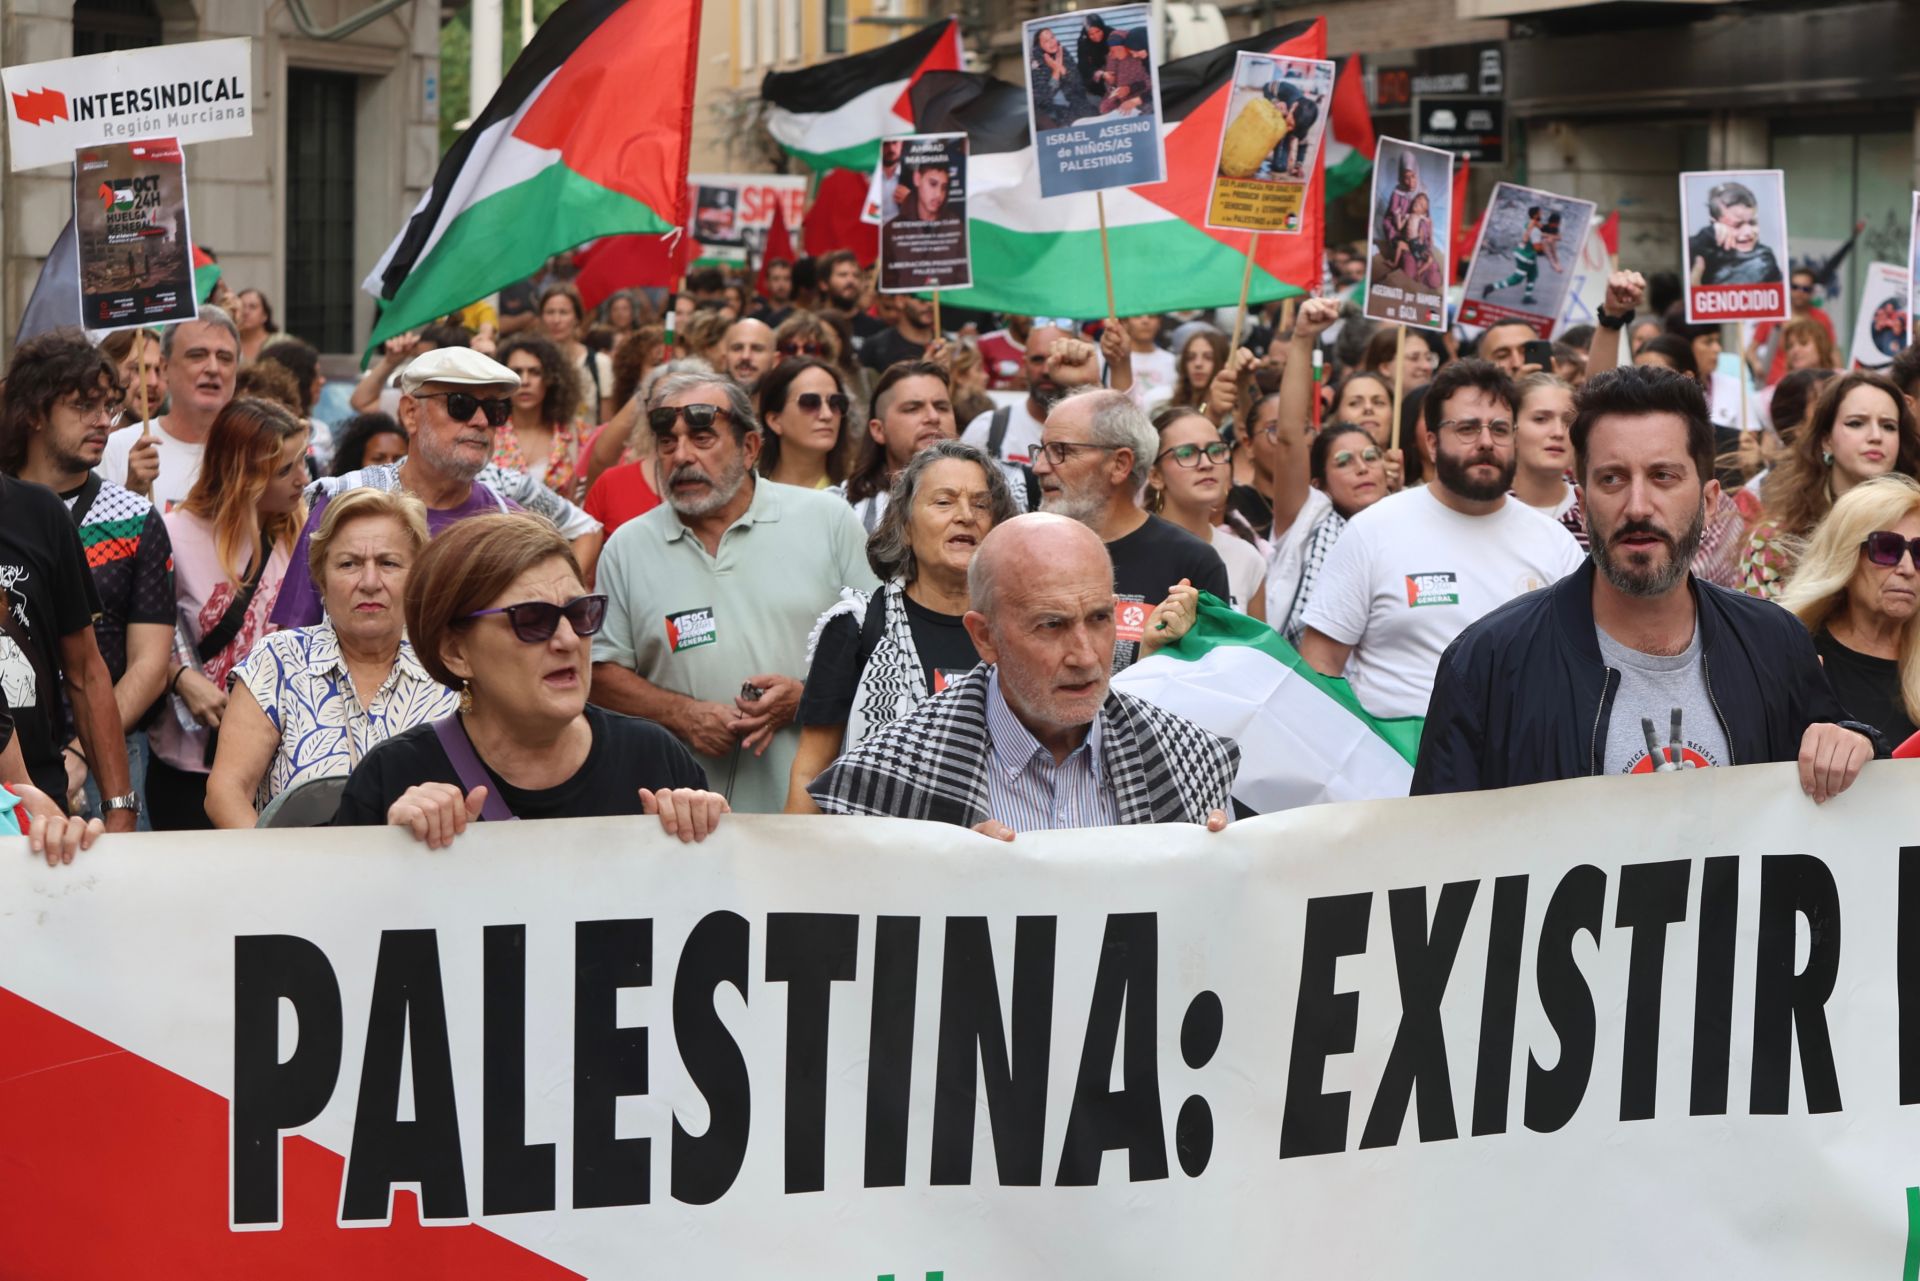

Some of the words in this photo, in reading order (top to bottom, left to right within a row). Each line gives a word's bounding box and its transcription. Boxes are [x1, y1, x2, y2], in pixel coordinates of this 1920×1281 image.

[73, 76, 245, 122] INTERSINDICAL
[103, 116, 161, 137] Región
[168, 105, 246, 128] Murciana
[1046, 131, 1090, 146] ISRAEL
[1099, 121, 1151, 138] ASESINO
[1057, 147, 1073, 159] de
[1074, 137, 1133, 157] NIÑOS/AS
[1060, 151, 1134, 173] PALESTINOS
[98, 178, 135, 213] 15
[133, 174, 161, 194] OCT
[134, 191, 161, 210] 24H
[106, 210, 147, 223] HUELGA
[1694, 289, 1780, 313] GENOCIDIO
[1433, 575, 1450, 583] OCT
[674, 615, 692, 632] 15
[691, 611, 708, 621] OCT
[679, 635, 712, 648] GENERAL
[232, 909, 1225, 1227] PALESTINA:
[1279, 853, 1844, 1161] EXISTIR
